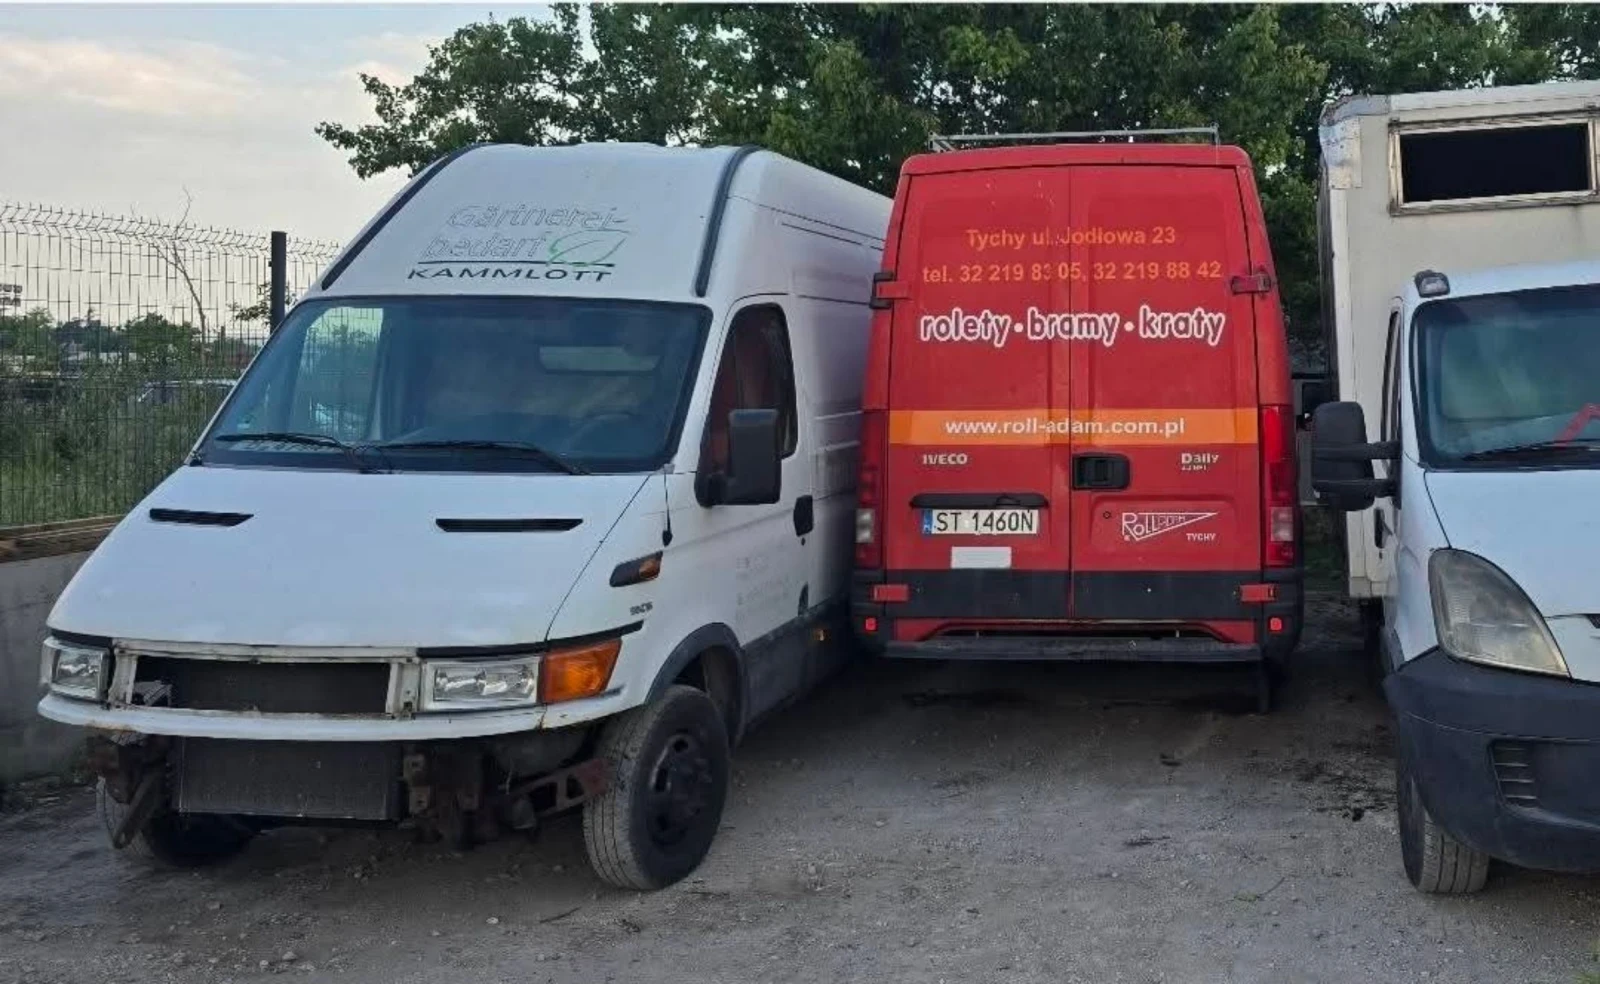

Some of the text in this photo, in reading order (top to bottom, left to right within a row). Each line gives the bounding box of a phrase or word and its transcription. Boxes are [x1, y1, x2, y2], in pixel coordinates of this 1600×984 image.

[966, 229, 1025, 251] Tychy
[1152, 227, 1176, 244] 23
[407, 268, 612, 282] KAMMLOTT
[923, 265, 953, 282] tel.
[960, 264, 982, 281] 32
[989, 264, 1024, 281] 219
[1093, 262, 1117, 280] 32
[1123, 261, 1159, 280] 219
[1166, 261, 1190, 279] 88
[1197, 260, 1222, 278] 42
[921, 305, 1226, 347] rolety bramy kraty
[945, 416, 1185, 438] www.roll-adam.com.pl
[922, 453, 968, 465] IVECO
[1181, 453, 1219, 464] Daily
[936, 512, 962, 532] ST
[1186, 533, 1217, 541] TYCHY
